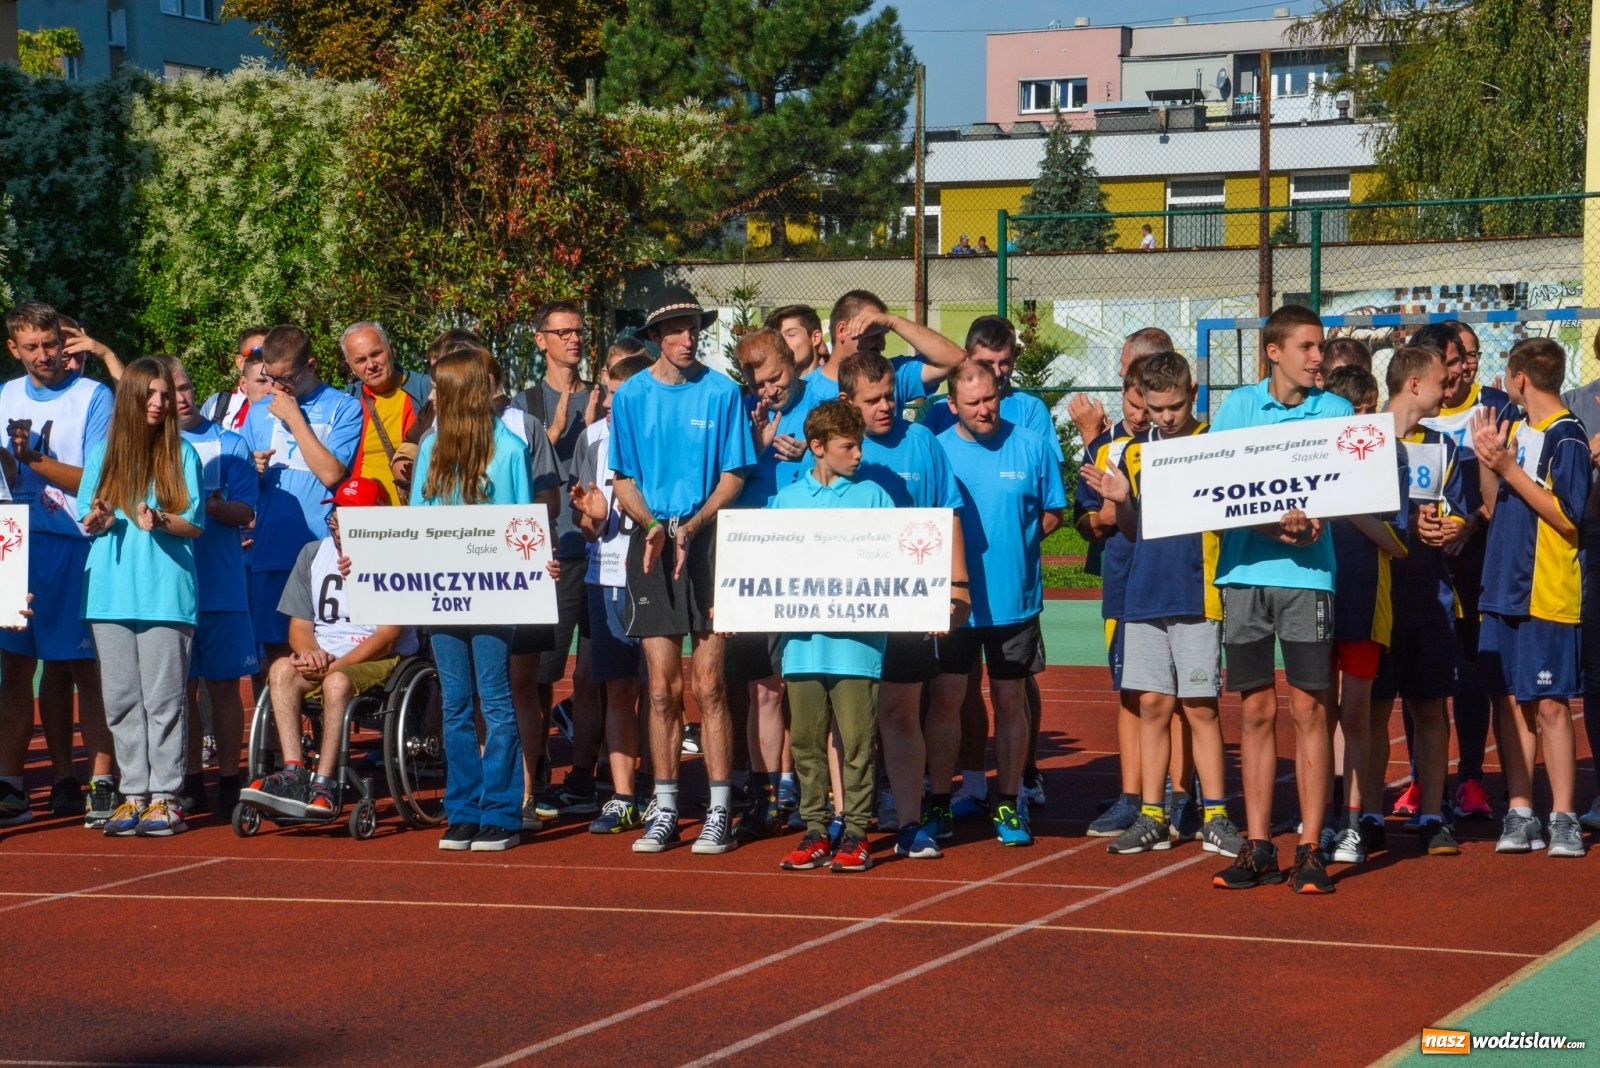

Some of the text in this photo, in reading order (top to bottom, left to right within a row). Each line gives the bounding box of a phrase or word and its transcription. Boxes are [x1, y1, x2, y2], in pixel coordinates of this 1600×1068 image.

[1151, 437, 1329, 468] Olimpiady Specjalne
[1291, 450, 1329, 464] Śląskie
[1225, 496, 1309, 518] MIEDARY
[349, 527, 496, 540] Olimpiady Specjalne
[726, 531, 805, 544] Olimpiady
[466, 543, 498, 556] Śląskie
[432, 592, 472, 611] ŻORY
[774, 599, 890, 623] RUDA ŚLĄSKA
